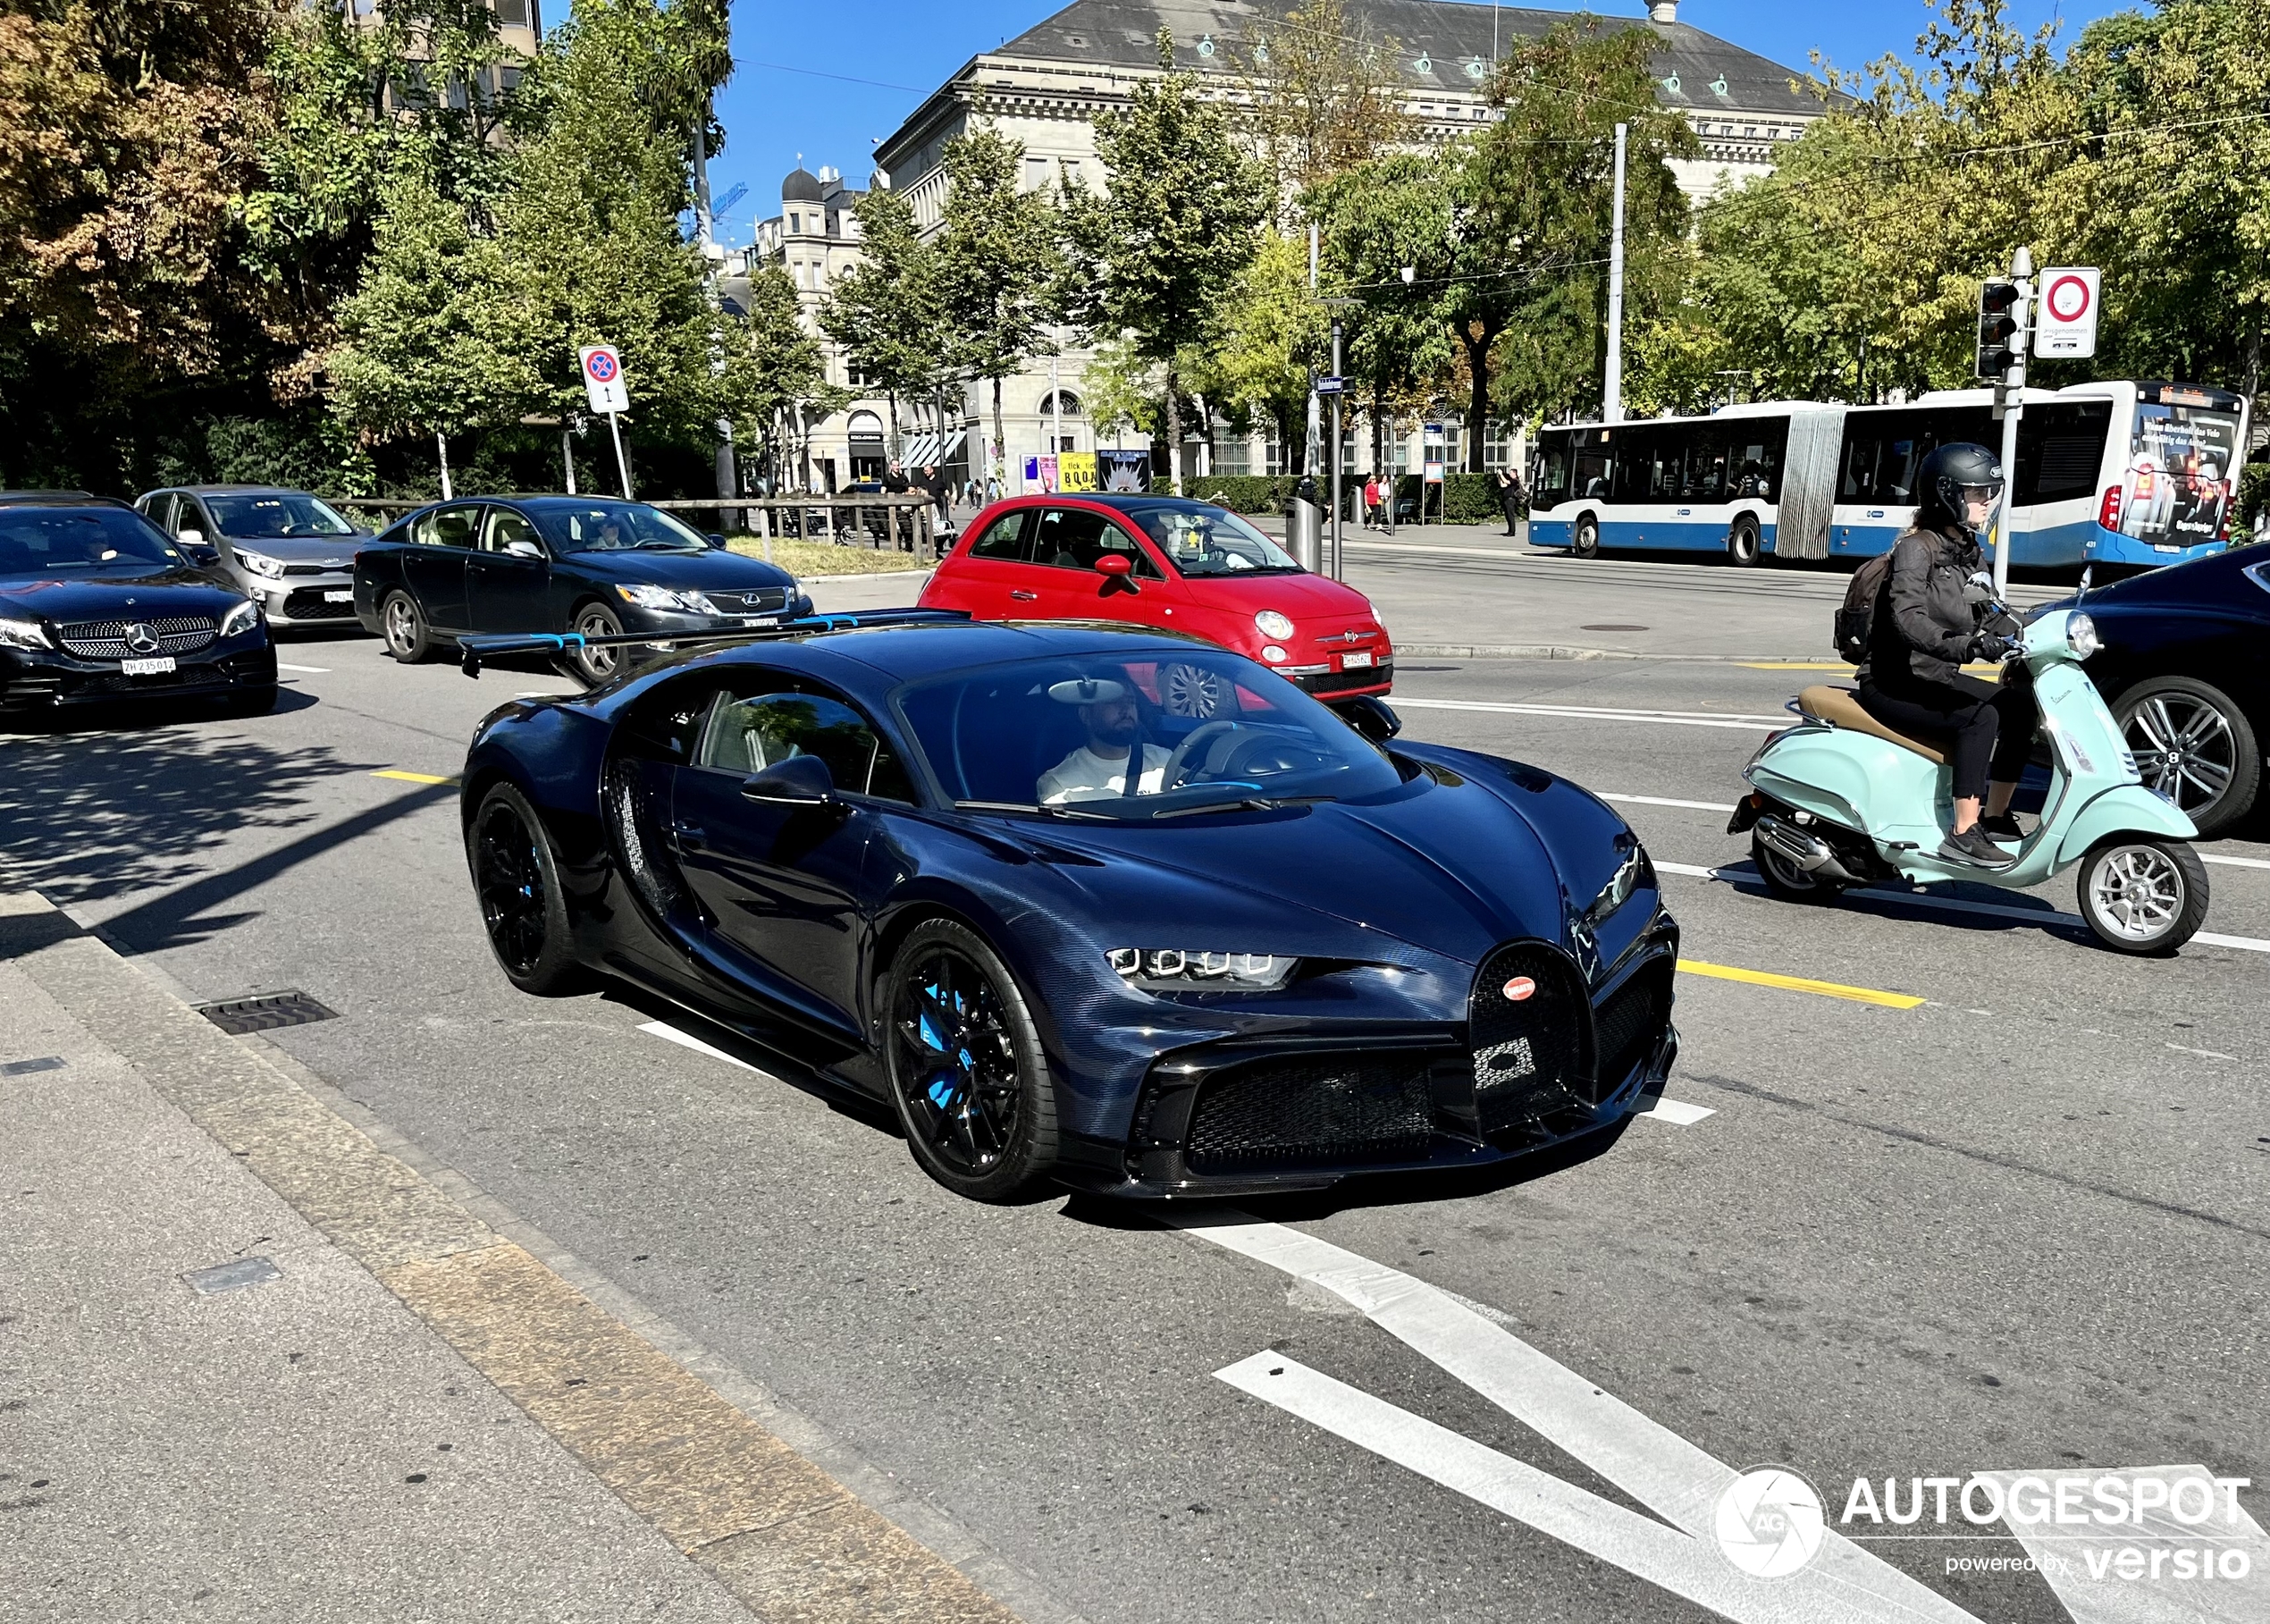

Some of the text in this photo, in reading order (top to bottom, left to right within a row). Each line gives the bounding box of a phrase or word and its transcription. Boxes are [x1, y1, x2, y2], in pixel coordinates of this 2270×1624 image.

[2144, 421, 2220, 438] Wann überholt das Velo
[2141, 433, 2207, 448] endgültig das Auto?
[2086, 540, 2097, 548] 431
[124, 660, 173, 671] ZH 235012
